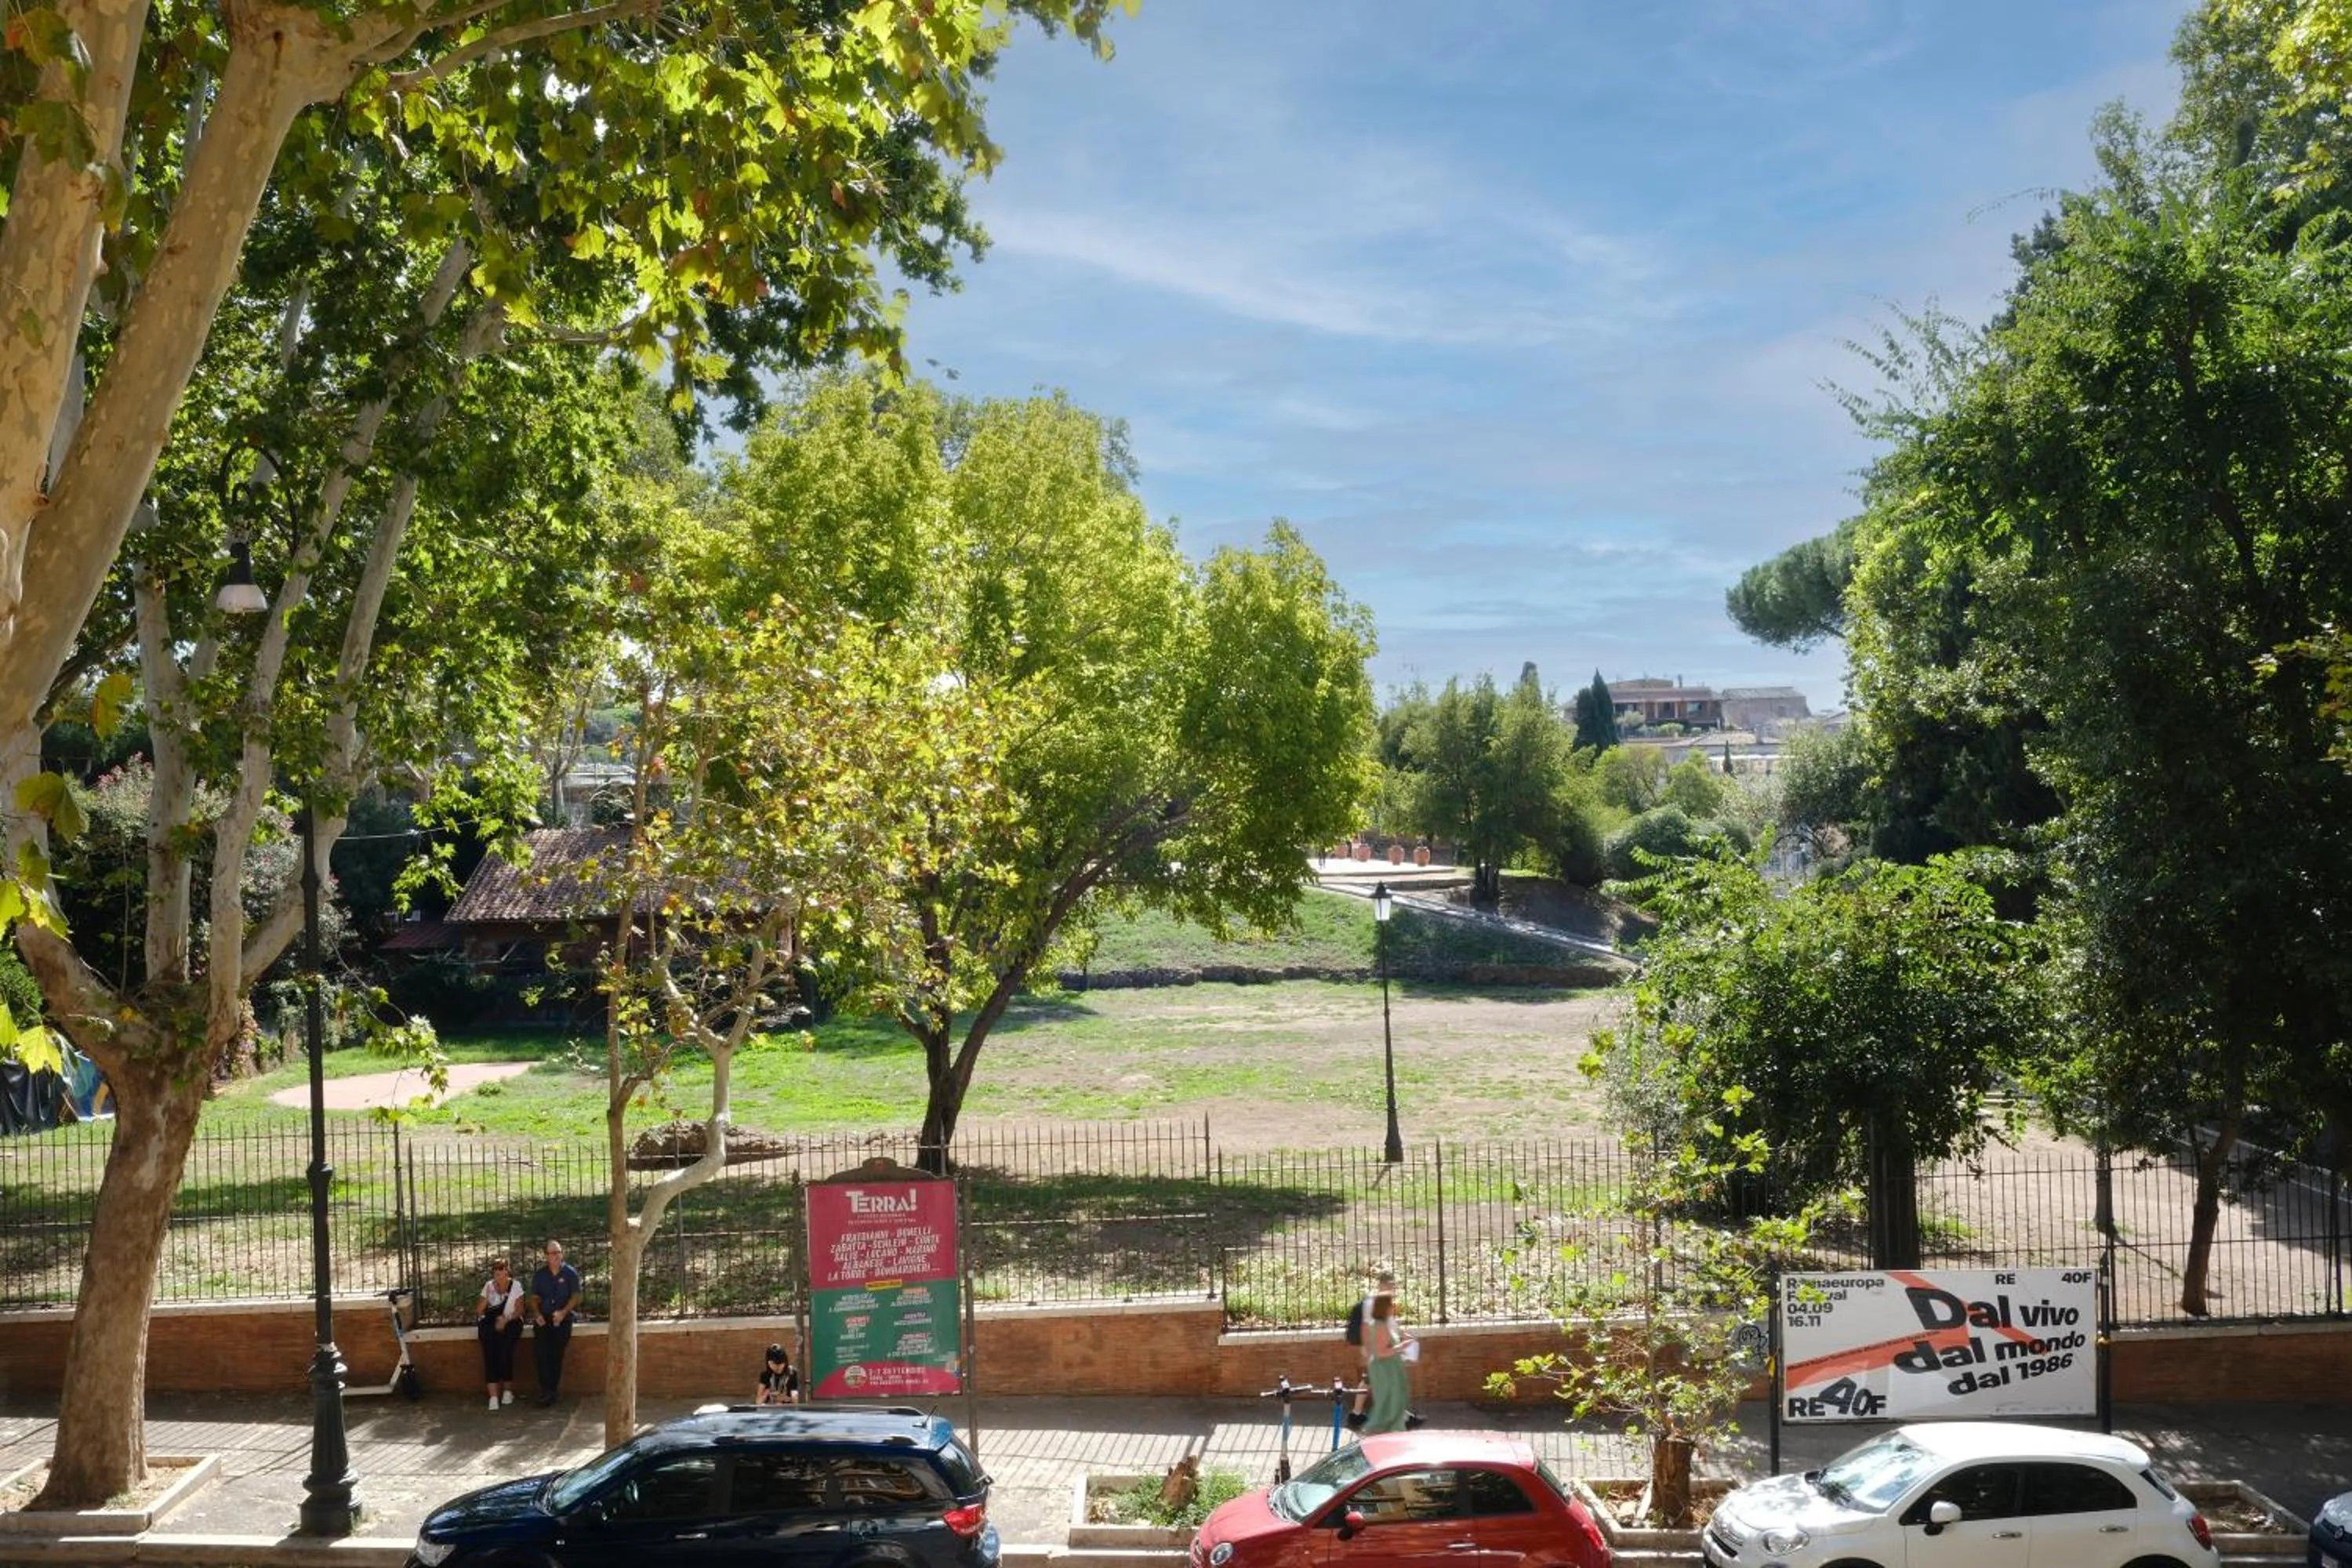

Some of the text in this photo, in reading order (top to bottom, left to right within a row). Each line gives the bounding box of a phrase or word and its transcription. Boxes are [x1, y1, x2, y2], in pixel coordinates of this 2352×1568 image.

[906, 1244, 937, 1255] MARINO
[827, 1272, 839, 1282] LA
[1995, 1273, 2016, 1285] RE
[2061, 1272, 2092, 1283] 40F
[1787, 1302, 1834, 1315] 04.09
[1905, 1287, 2079, 1330] Dal vivo
[1787, 1315, 1821, 1327] 16.11
[1894, 1337, 1987, 1374] dal
[1995, 1331, 2086, 1361] mondo
[1947, 1352, 2074, 1396] dal 1986
